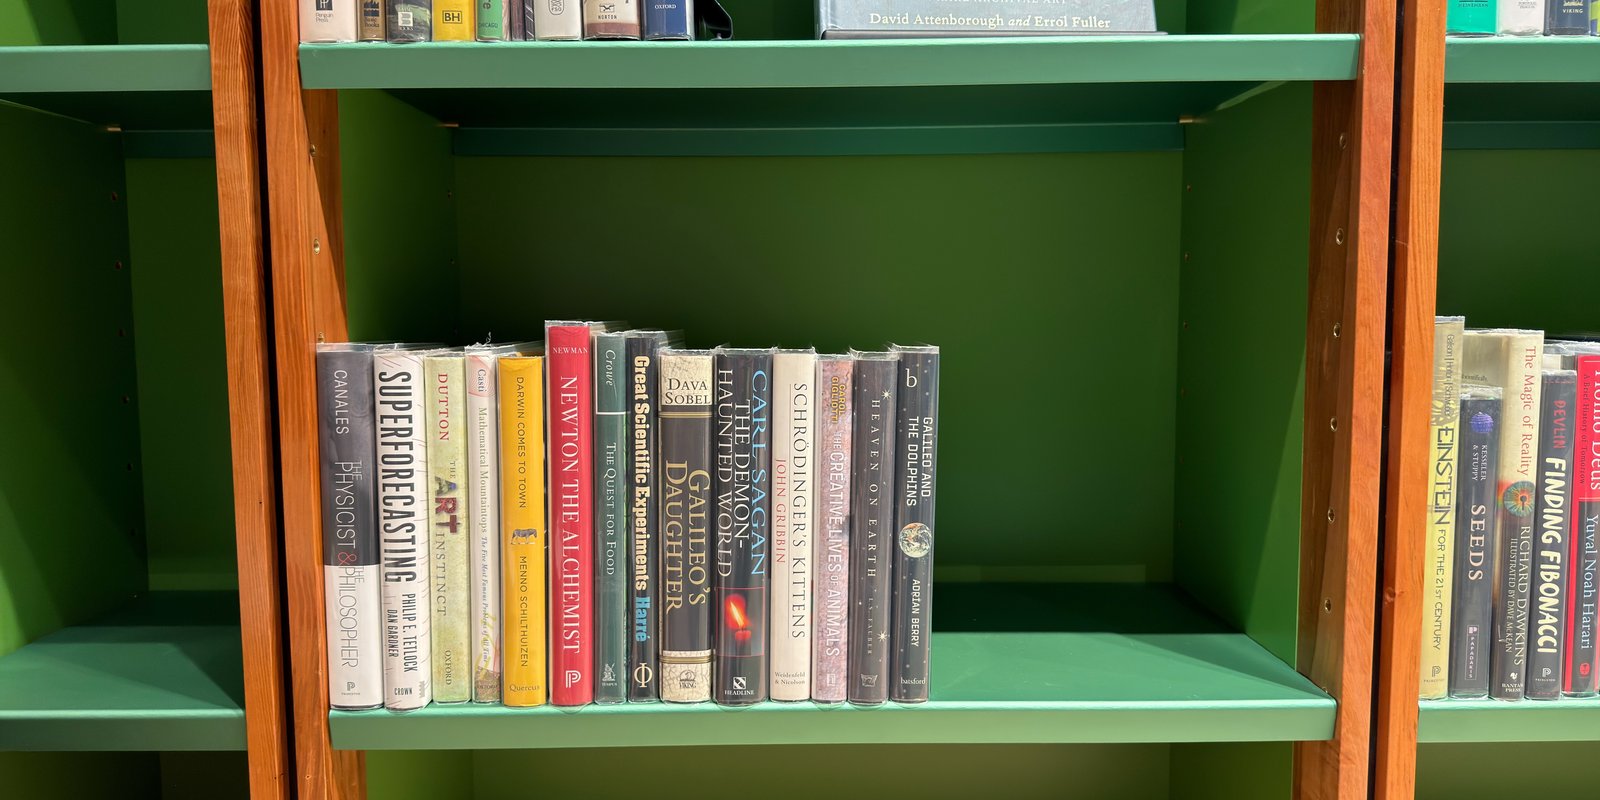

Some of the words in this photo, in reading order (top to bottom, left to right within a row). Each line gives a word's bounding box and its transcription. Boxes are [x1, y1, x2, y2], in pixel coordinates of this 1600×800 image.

[445, 13, 460, 21] BH
[870, 13, 909, 25] David
[914, 13, 1004, 29] Attenborough
[1009, 16, 1031, 26] and
[1035, 16, 1067, 27] Errol
[1072, 17, 1111, 28] Fuller
[605, 350, 616, 385] Crowe
[634, 356, 650, 400] Great
[1525, 346, 1536, 368] The
[334, 370, 349, 434] CANALES
[478, 369, 487, 392] Casti
[517, 377, 525, 418] DARWIN
[665, 391, 711, 404] SOBEL
[668, 378, 707, 390] DAVA
[831, 376, 839, 424] GIGLIOTTI
[838, 384, 846, 416] CAROL
[1520, 375, 1535, 410] Magic
[438, 374, 449, 441] DUTTON
[561, 376, 578, 472] NEWTON
[718, 369, 733, 482] HAUNTED
[734, 400, 750, 445] THE
[752, 370, 767, 458] CARL
[908, 416, 919, 438] THE
[1522, 416, 1534, 432] of
[1553, 400, 1567, 449] DEVLIN
[1580, 403, 1589, 432] History
[479, 407, 488, 471] Mathematical
[606, 443, 616, 465] THE
[634, 402, 650, 483] Scientific
[870, 400, 880, 471] HEAVEN
[921, 417, 933, 468] GALILEO
[1517, 434, 1533, 476] Reality
[1581, 434, 1587, 442] of
[352, 460, 362, 480] THE
[378, 372, 417, 582] SUPERFORECASTING
[518, 461, 526, 474] TO
[776, 459, 787, 497] JOHN
[793, 383, 809, 547] SCHRÖDINGER'S
[906, 445, 918, 506] DOLPHINS
[921, 473, 931, 497] AND
[1434, 426, 1454, 525] EINSTEIN
[335, 462, 355, 549] PHYSICIST
[435, 476, 459, 534] ART
[478, 473, 488, 533] Mountaintops
[562, 479, 579, 524] THE
[604, 468, 616, 508] QUEST
[733, 452, 750, 548] DEMON-
[829, 452, 845, 525] CREATIVE
[869, 484, 879, 506] ON
[1541, 457, 1566, 544] FINDING
[606, 514, 615, 536] FOR
[632, 487, 650, 591] Experiments
[665, 460, 688, 614] DAUGHTER
[688, 469, 710, 605] GALILEO'S
[717, 491, 732, 577] WORLD
[751, 468, 767, 575] SAGAN
[776, 504, 787, 563] GRIBBIN
[1437, 529, 1446, 552] FOR
[1468, 505, 1486, 581] SEEDS
[1585, 515, 1599, 554] Yuval
[338, 552, 357, 565] &
[606, 542, 616, 575] FOOD
[828, 529, 842, 573] LIVES
[867, 518, 877, 577] EARTH
[1437, 554, 1445, 574] THE
[1509, 538, 1518, 588] ILLUSTRATED
[1517, 526, 1531, 593] RICHARD
[354, 566, 364, 583] THE
[435, 533, 446, 616] INSTINCT
[562, 530, 580, 653] ALCHEMIST
[831, 575, 838, 586] OF
[912, 579, 920, 614] ADRIAN
[1435, 578, 1444, 599] 21ST
[1508, 590, 1515, 599] BY
[1583, 559, 1596, 598] Noah
[339, 567, 358, 668] PHILOSOPHER
[387, 609, 398, 623] DAN
[402, 594, 416, 621] PHILIP
[635, 597, 650, 642] Harré
[792, 557, 806, 638] KITTENS
[1537, 551, 1561, 653] FIBONACCI
[388, 625, 399, 657] GARDNER
[403, 625, 416, 633] E.
[520, 596, 528, 667] SCHILTHUIZEN
[826, 588, 841, 656] ANIMALS
[911, 618, 920, 647] BERRY
[1433, 601, 1443, 650] CENTURY
[1505, 621, 1514, 653] McKEAN
[1514, 599, 1528, 666] DAWKINS
[1581, 602, 1595, 649] Harari
[403, 636, 417, 672] TETLOCK
[509, 683, 539, 692] Quercus
